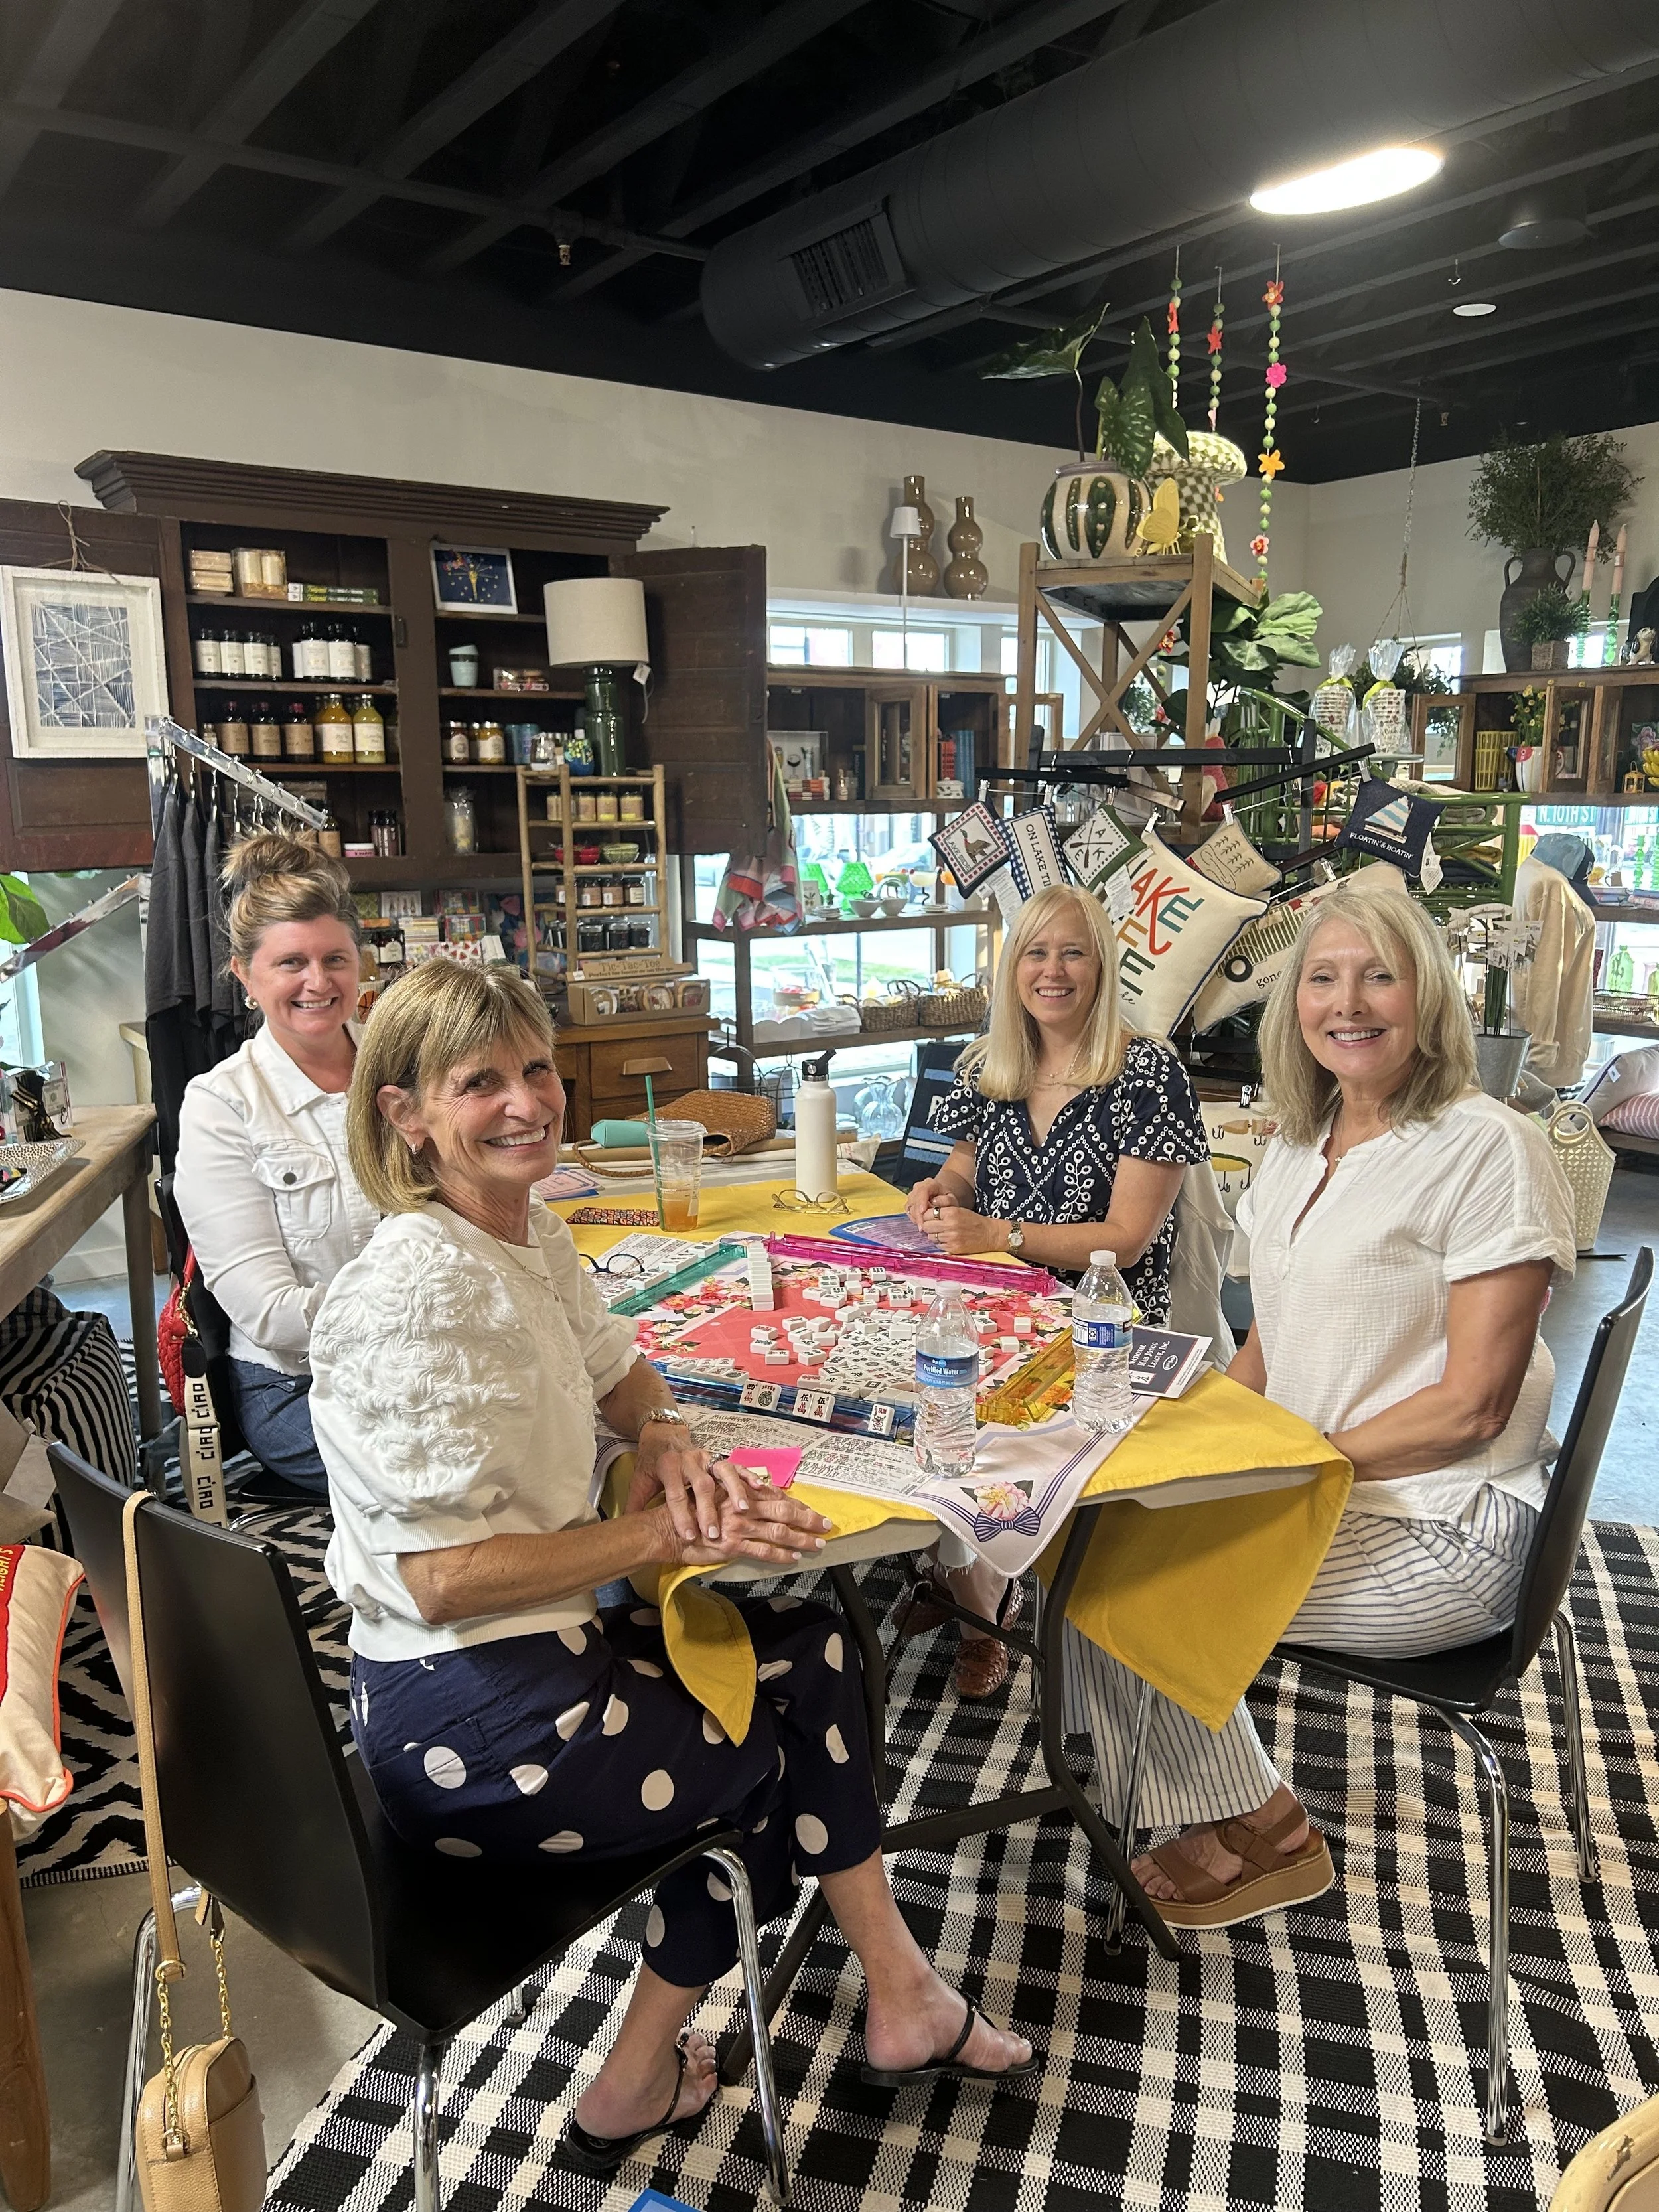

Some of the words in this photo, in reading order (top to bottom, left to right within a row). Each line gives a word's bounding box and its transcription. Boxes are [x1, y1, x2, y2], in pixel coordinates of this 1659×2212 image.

[1553, 806, 1578, 823] 10TH
[1026, 824, 1037, 842] ON
[947, 838, 961, 855] LAKE
[1349, 832, 1382, 848] FLOATIN'
[1380, 840, 1387, 849] &
[1386, 844, 1415, 860] BOATIN'
[1030, 843, 1048, 873] LAKE
[1042, 871, 1052, 888] TI
[1114, 917, 1156, 996] FE
[599, 959, 661, 972] Tic-Tac-Toe
[1128, 1343, 1147, 1365] NATIONAL
[1137, 1356, 1149, 1367] MAH
[923, 1363, 942, 1375] Purified
[942, 1366, 959, 1376] Water
